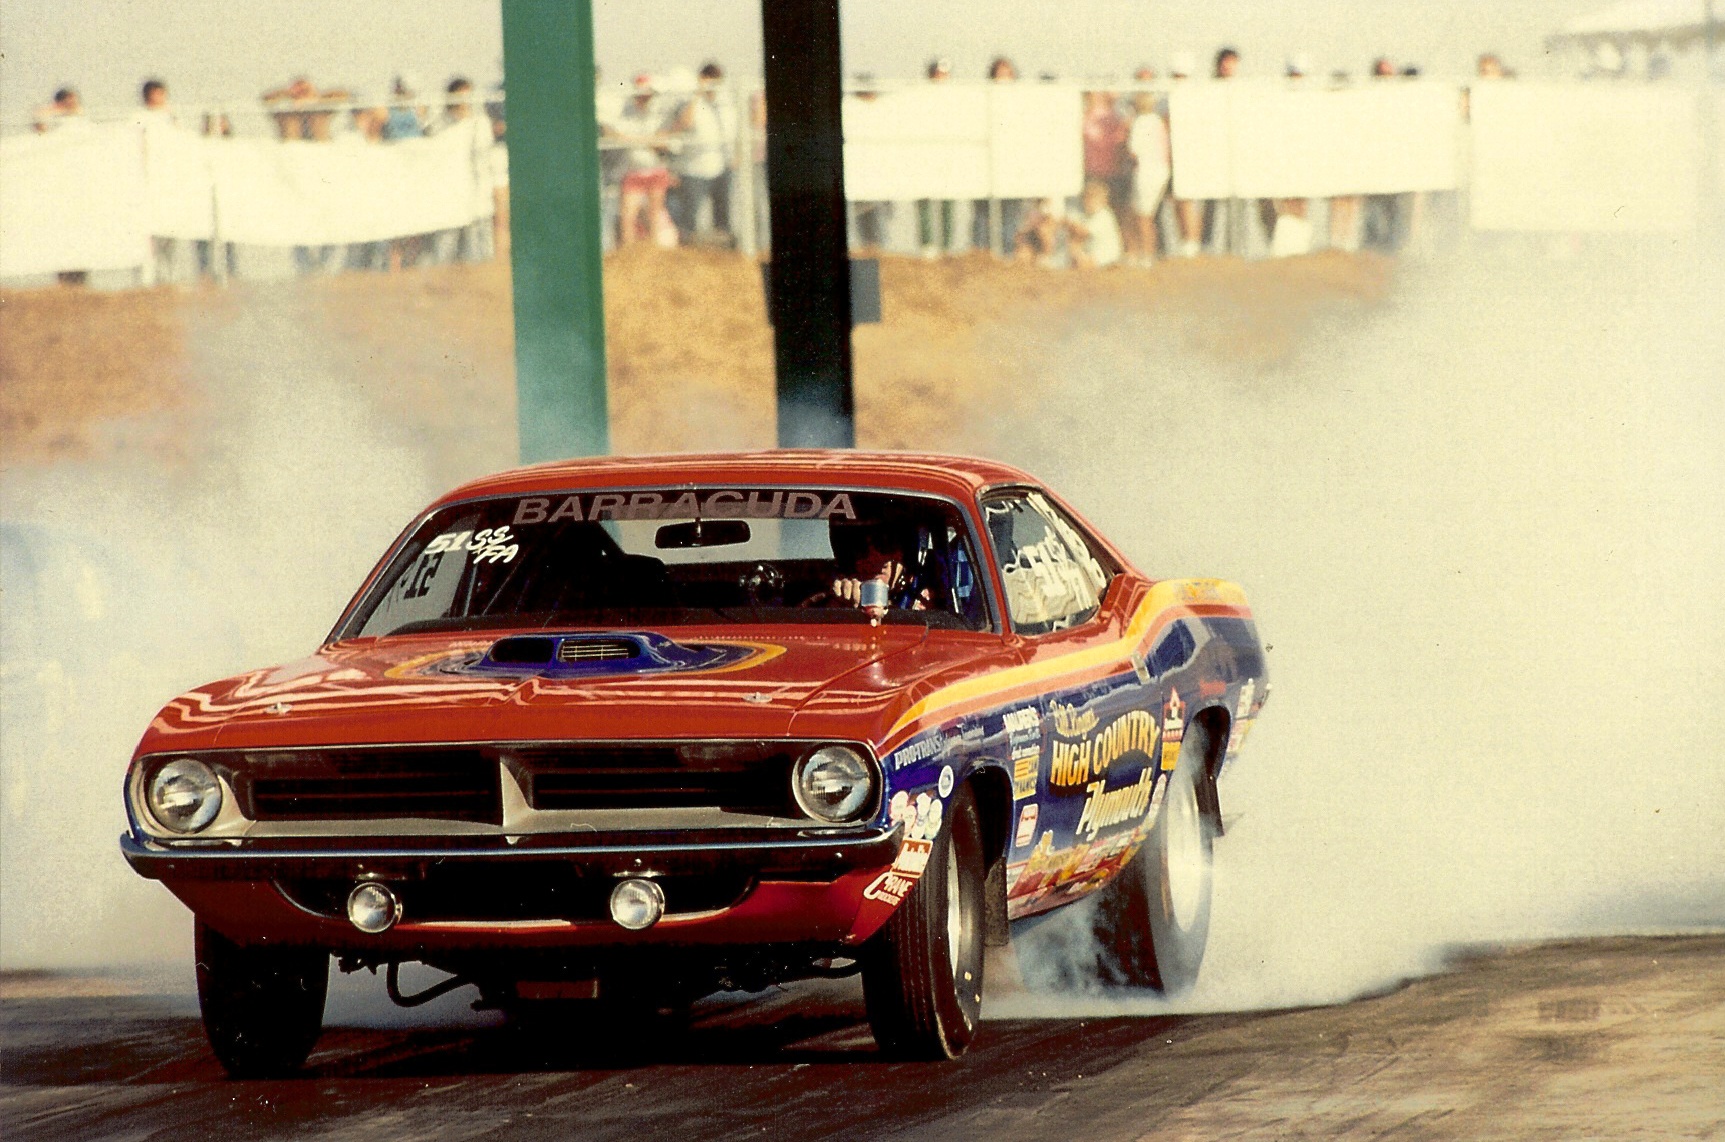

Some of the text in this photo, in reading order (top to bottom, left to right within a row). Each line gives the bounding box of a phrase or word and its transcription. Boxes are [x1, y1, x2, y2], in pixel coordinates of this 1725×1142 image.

[513, 491, 856, 525] BARRACUDA
[425, 530, 472, 555] 51
[1050, 740, 1092, 787] HIGH
[1093, 710, 1160, 775] COUNTRY
[1075, 767, 1152, 841] Plymouth
[863, 871, 913, 900] CRANE
